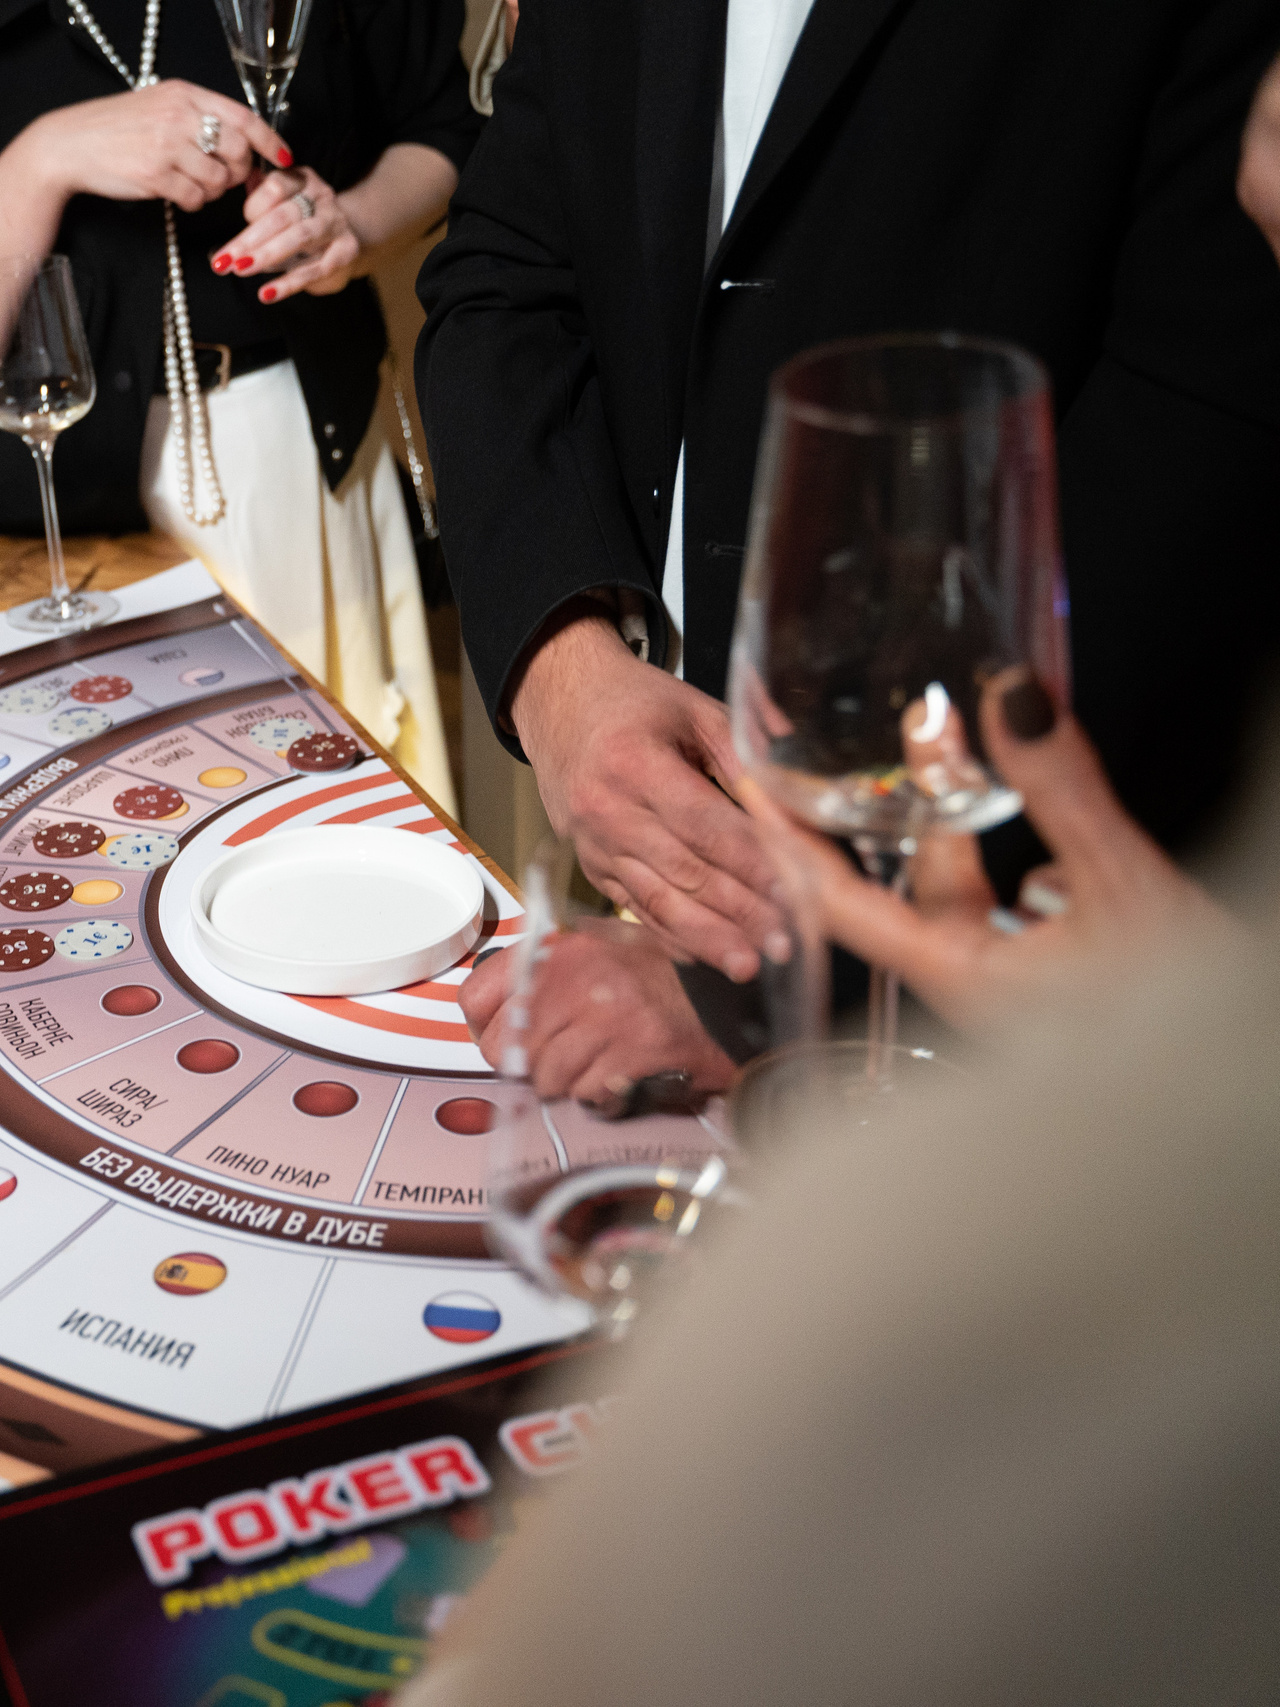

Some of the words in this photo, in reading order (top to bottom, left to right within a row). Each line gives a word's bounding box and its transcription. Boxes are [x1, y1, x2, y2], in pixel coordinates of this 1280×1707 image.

[151, 746, 195, 769] ПИНО
[19, 997, 74, 1047] КАБЕРНЕ
[75, 1088, 142, 1130] ШИРАЗ
[108, 1077, 169, 1112] СИРА/
[206, 1145, 269, 1175] ПИНО
[269, 1164, 331, 1190] НУАР
[79, 1146, 134, 1180] БЕЗ
[124, 1165, 282, 1231] ВЫДЕРЖКИ
[282, 1211, 308, 1236] В
[305, 1216, 389, 1247] ДУБЕ
[374, 1181, 492, 1205] ТЕМПРАН
[58, 1307, 197, 1370] ИСПАНИЯ
[130, 1436, 492, 1587] POKER
